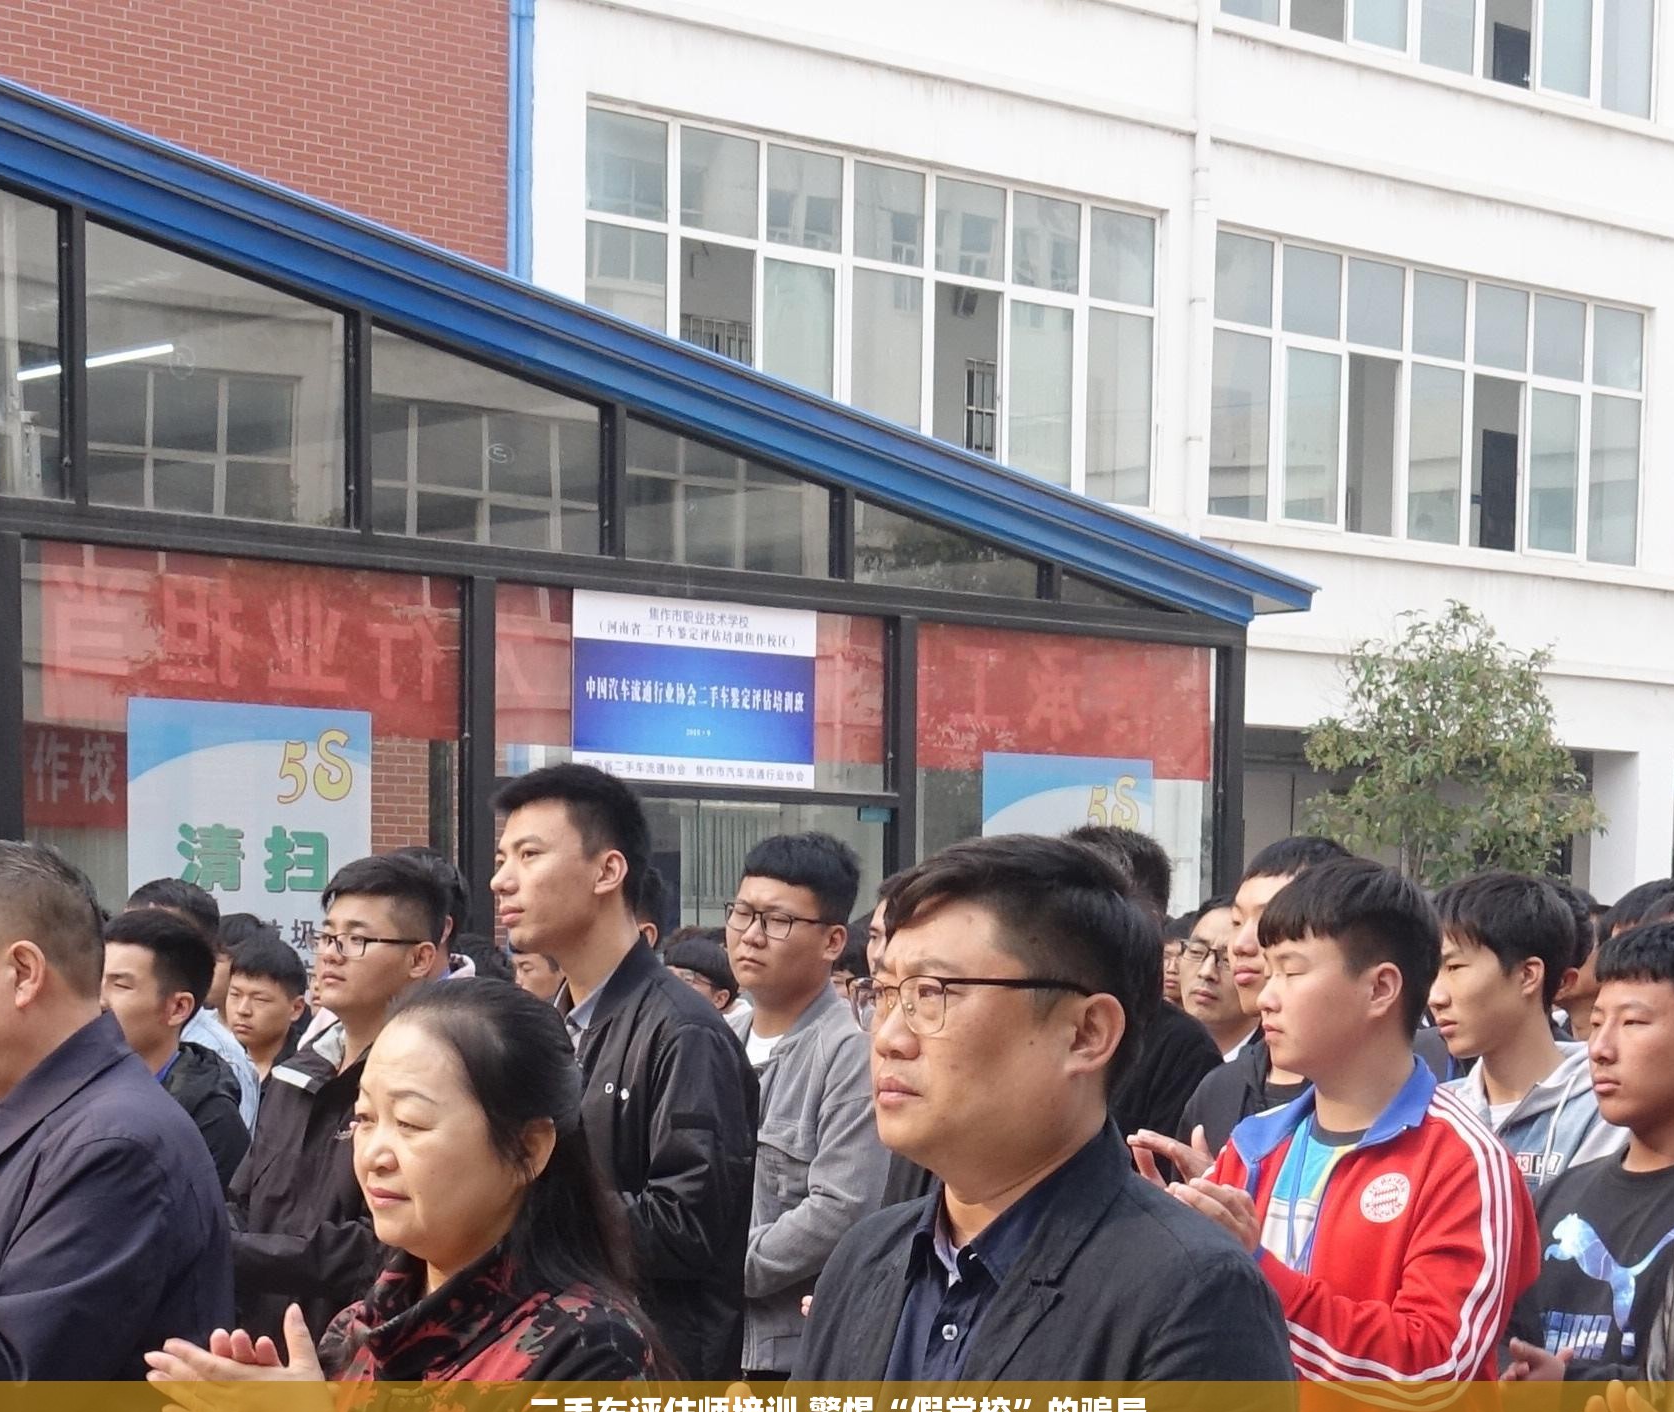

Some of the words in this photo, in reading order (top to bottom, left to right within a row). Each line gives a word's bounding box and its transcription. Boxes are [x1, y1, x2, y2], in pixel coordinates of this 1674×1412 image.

[277, 729, 353, 805] 5S
[1088, 774, 1140, 831] 5S
[176, 822, 330, 894] 清扫
